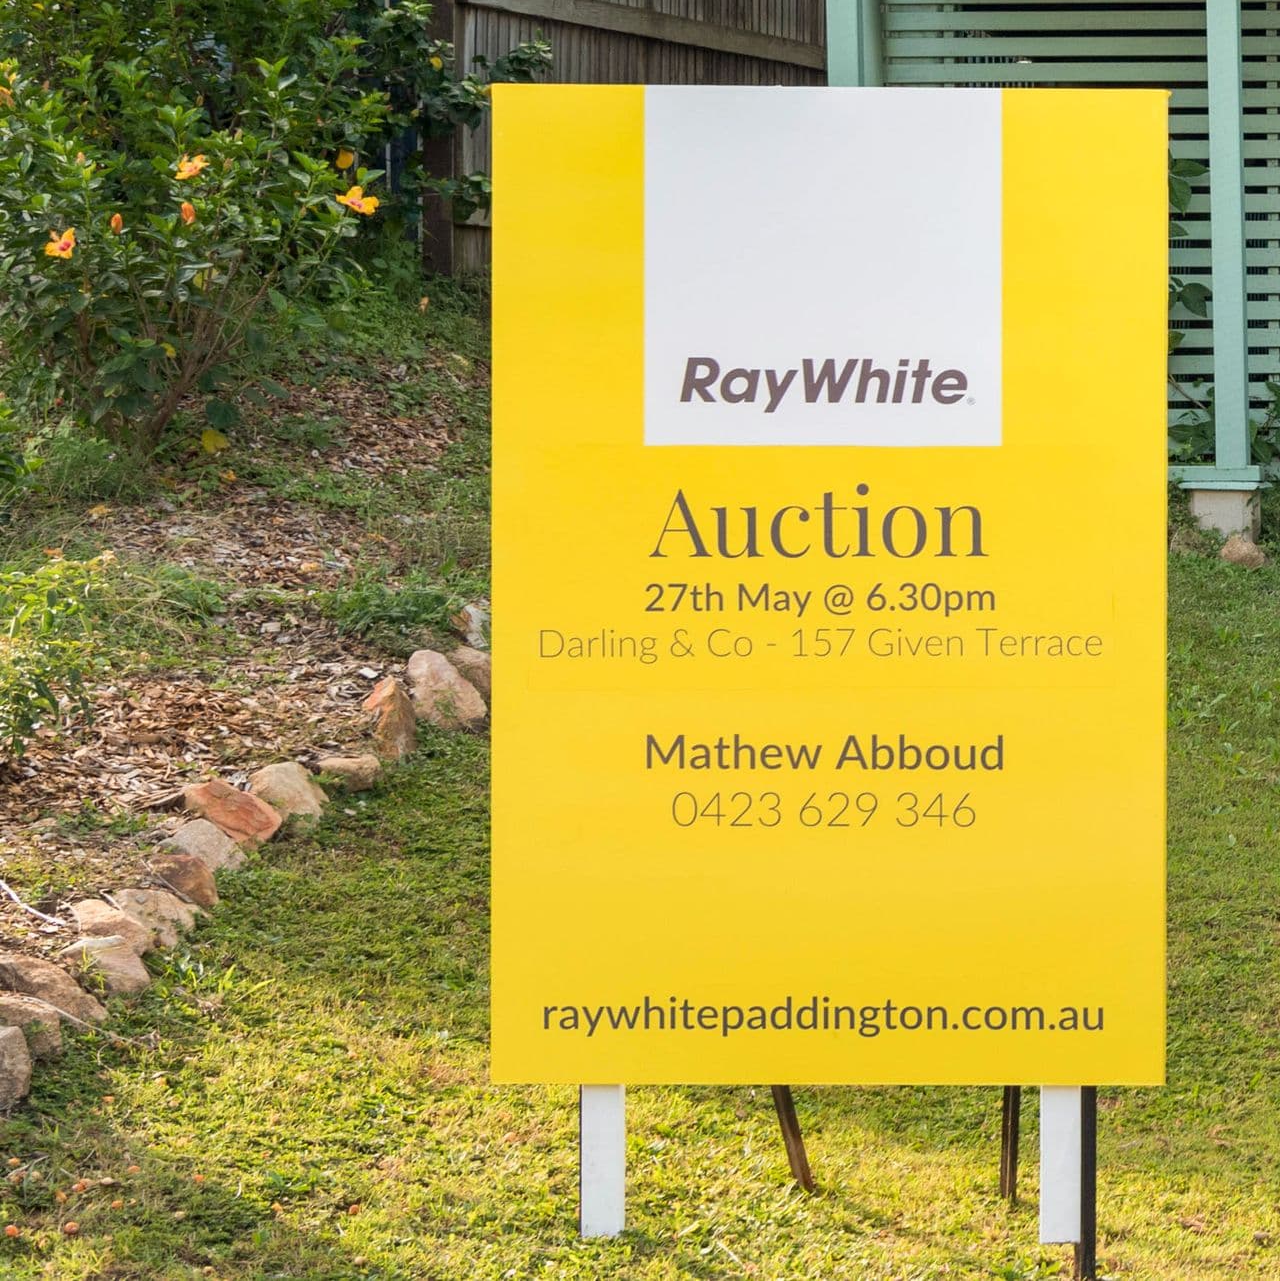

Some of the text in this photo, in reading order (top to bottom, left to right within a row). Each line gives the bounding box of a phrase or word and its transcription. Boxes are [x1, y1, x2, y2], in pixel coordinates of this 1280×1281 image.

[648, 483, 991, 560] Auction
[644, 582, 996, 619] 27th May @ 6.30pm
[538, 628, 658, 665] Darling
[670, 629, 695, 659] &
[707, 628, 753, 659] Co
[792, 628, 856, 659] 157
[868, 628, 964, 659] Given
[976, 627, 1104, 659] Terrace
[645, 735, 1005, 772] Mathew Abboud
[672, 790, 977, 829] 0423 629 346
[542, 995, 1105, 1038] raywhitepaddington.com.au
